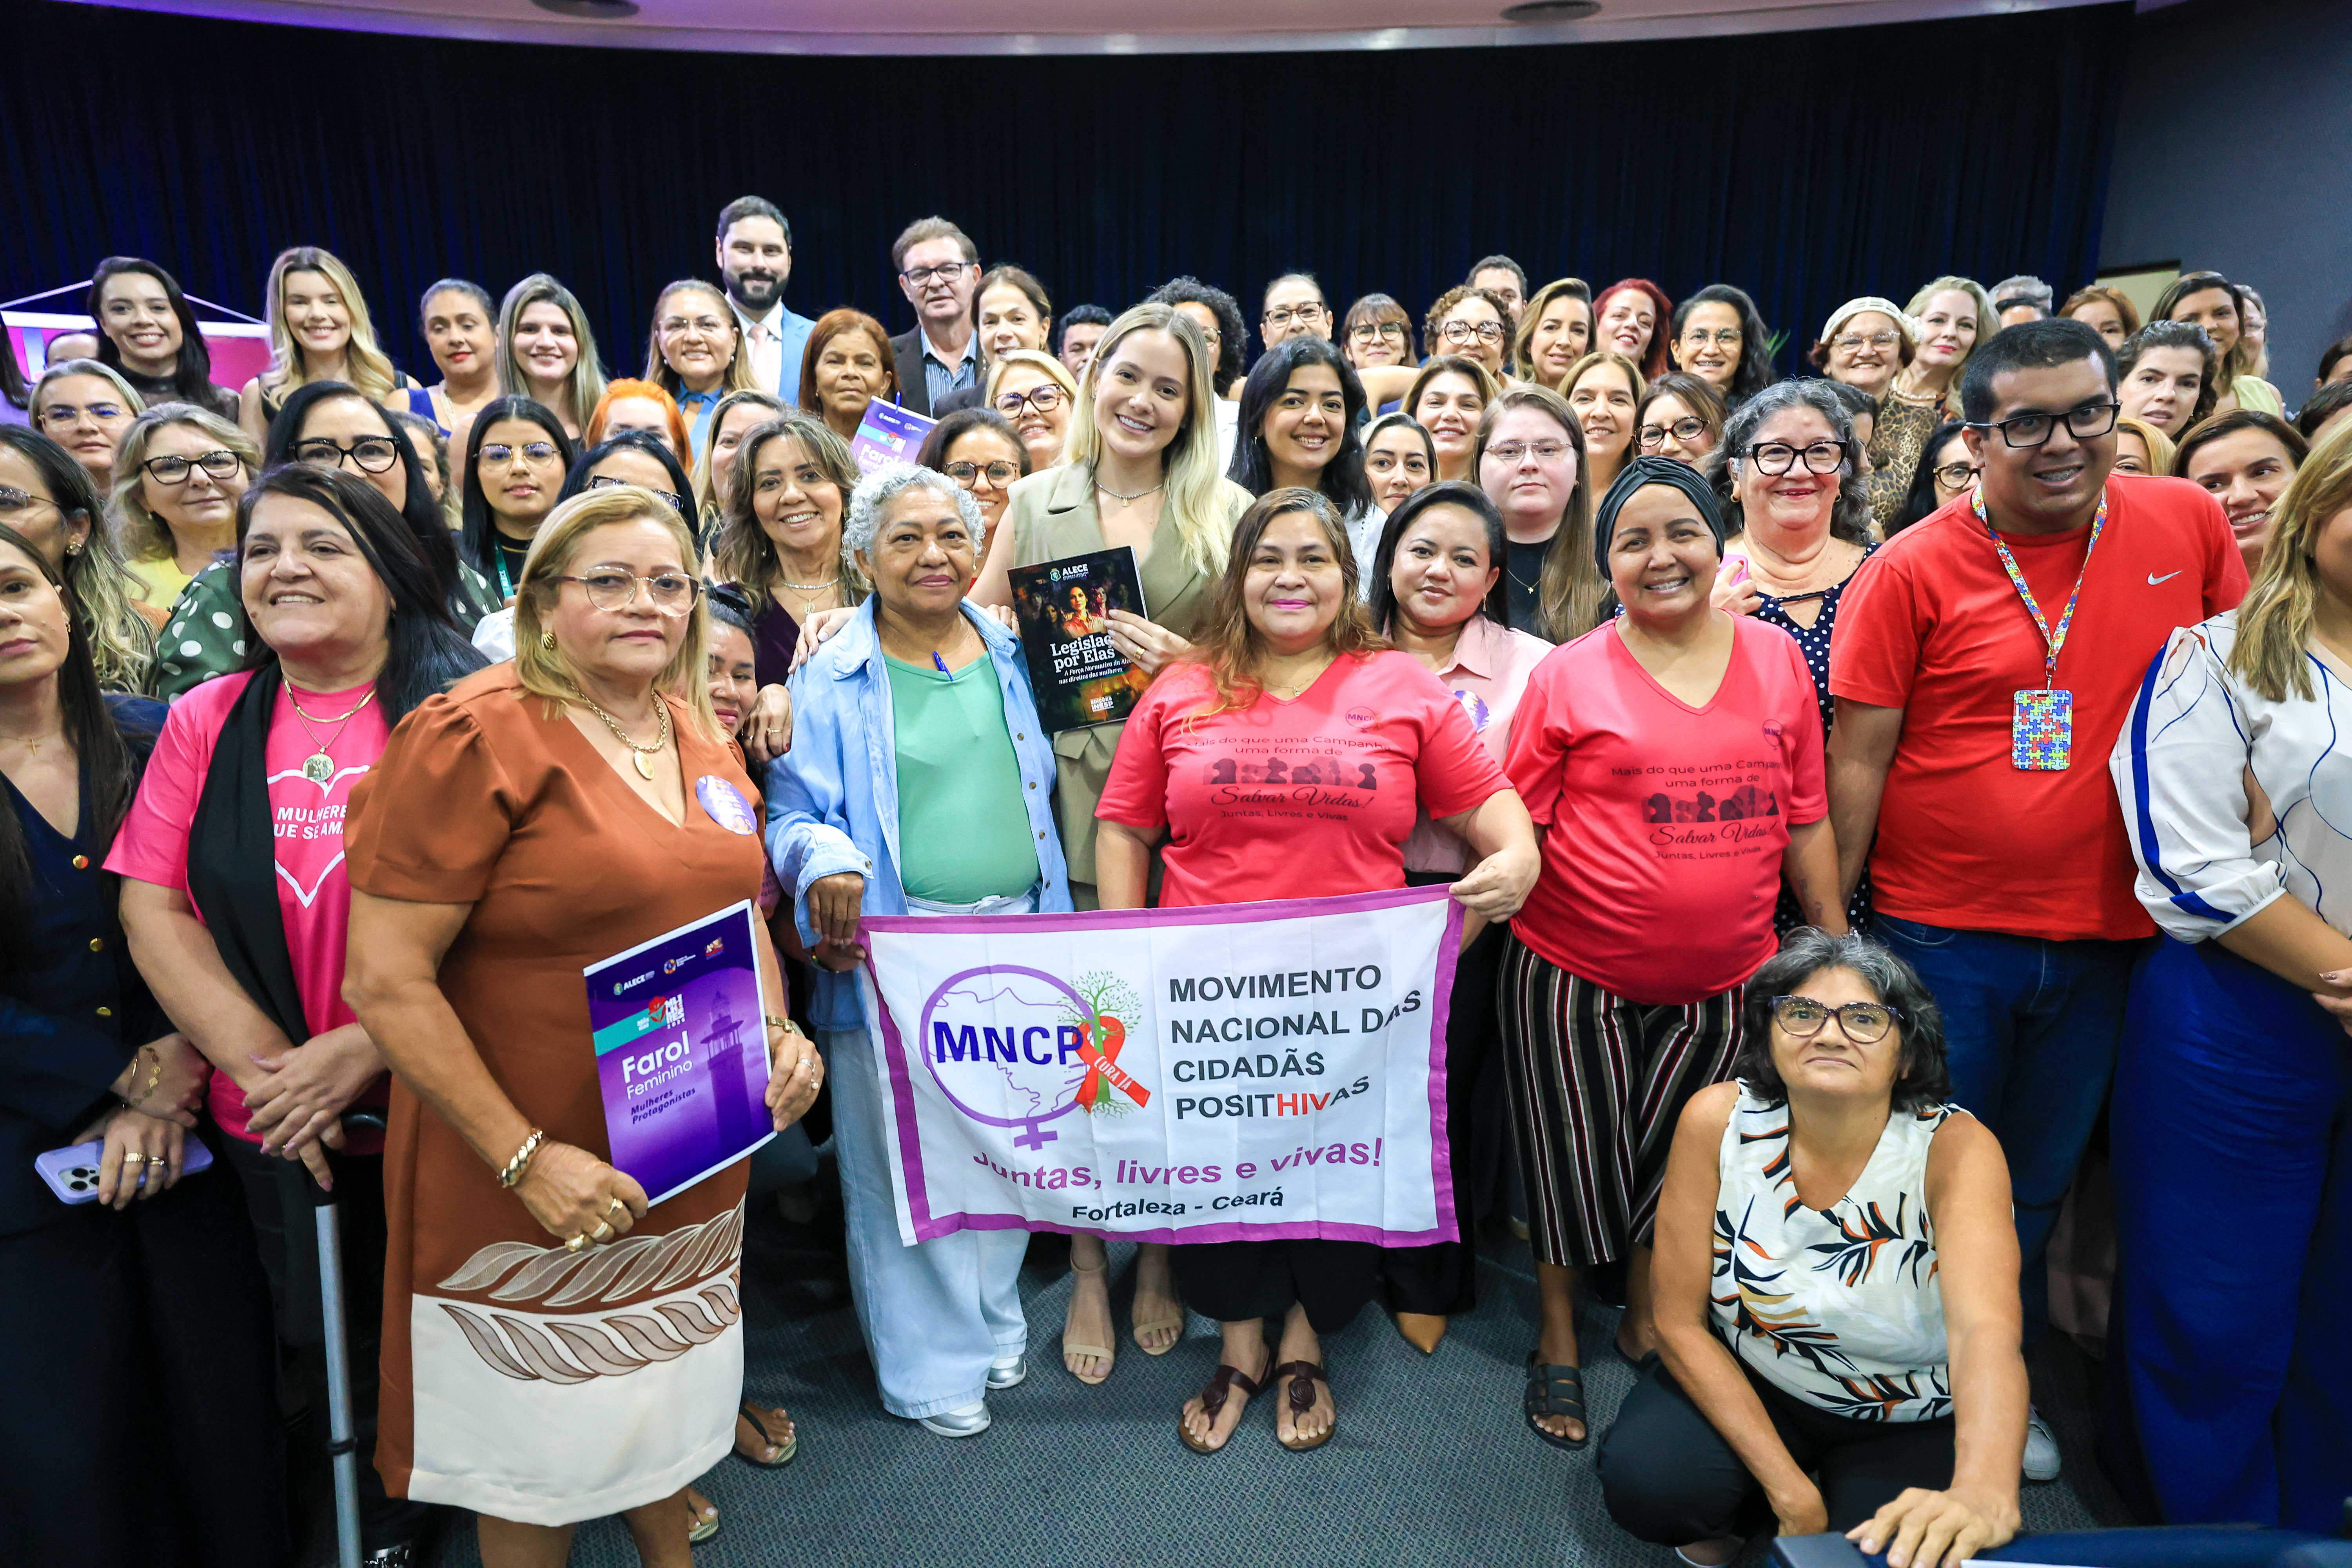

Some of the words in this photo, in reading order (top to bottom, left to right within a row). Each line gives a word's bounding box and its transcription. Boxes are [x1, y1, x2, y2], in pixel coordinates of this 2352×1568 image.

[858, 456, 882, 470] Femin
[861, 443, 899, 467] Farol
[1062, 563, 1088, 576] ALECE
[1050, 635, 1112, 657] Legislaç
[1054, 655, 1080, 673] por
[1082, 648, 1115, 664] Elas
[1085, 661, 1112, 672] Normativa
[1069, 674, 1088, 683] direitos
[1099, 667, 1123, 677] mulheres
[1091, 701, 1113, 710] INESP
[1612, 767, 1642, 776] Mais
[1669, 767, 1695, 775] que
[1700, 764, 1731, 772] uma
[1701, 775, 1742, 786] forma
[1211, 786, 1286, 805] Salvar
[1292, 786, 1374, 809] Vidas!
[277, 804, 347, 824] MULHERE
[1317, 812, 1348, 821] Vivas
[274, 823, 298, 838] UE
[302, 824, 319, 840] SE
[320, 821, 343, 837] AM
[1650, 826, 1716, 845] Salvar
[1721, 821, 1777, 842] Vidas!
[1742, 846, 1761, 855] Vivas
[624, 974, 646, 990] ALECE
[1170, 965, 1381, 1002] MOVIMENTO
[1172, 1011, 1350, 1043] NACIONAL
[1362, 990, 1421, 1033] DAS
[933, 1022, 1084, 1065] MNCP
[622, 1030, 691, 1083] Farol
[1094, 1056, 1120, 1081] CURA
[1173, 1048, 1325, 1082] CIDADÃS
[626, 1060, 693, 1100] Feminino
[631, 1090, 673, 1115] Mulheres
[632, 1087, 696, 1124] Protagonistas
[1177, 1076, 1370, 1120] POSITHIVAS
[973, 1152, 1102, 1190] Juntas,
[1116, 1160, 1221, 1185] livres
[1236, 1163, 1257, 1179] e
[1271, 1138, 1382, 1172] vivas!
[1073, 1198, 1186, 1221] Fortaleza
[1212, 1186, 1283, 1210] Ceará
